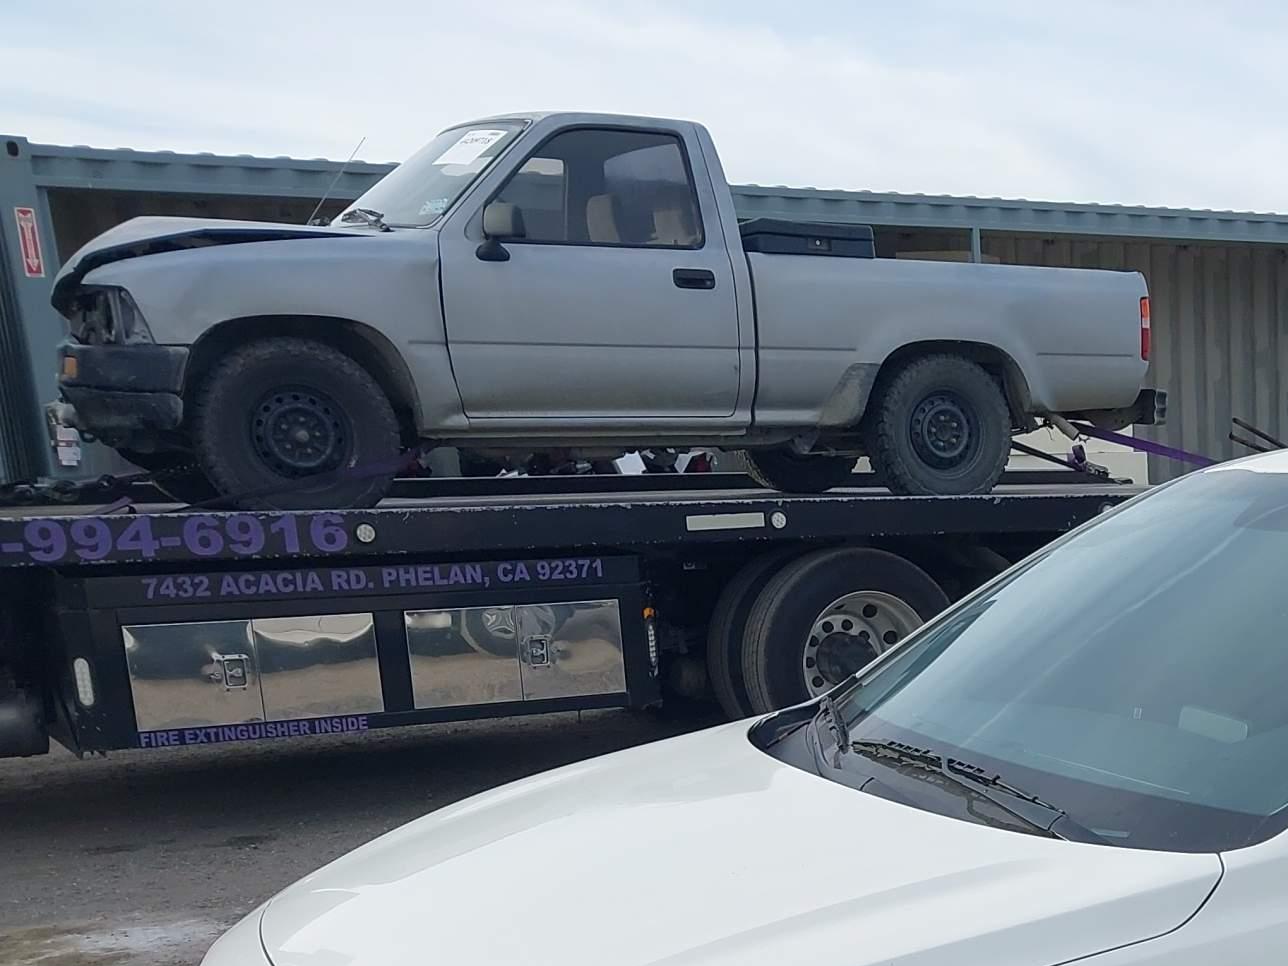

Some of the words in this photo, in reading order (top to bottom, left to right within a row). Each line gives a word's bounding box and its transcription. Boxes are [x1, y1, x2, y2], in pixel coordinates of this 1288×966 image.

[1, 513, 348, 562] -994-6916
[141, 575, 211, 599] 7432
[220, 572, 324, 596] ACACIA
[331, 569, 374, 591] RD.
[382, 565, 490, 588] PHELAN,
[497, 562, 530, 583] CA
[537, 559, 603, 580] 92371
[139, 731, 179, 748] FIRE
[184, 720, 311, 745] EXTINGUISHER
[315, 716, 369, 734] INSIDE
